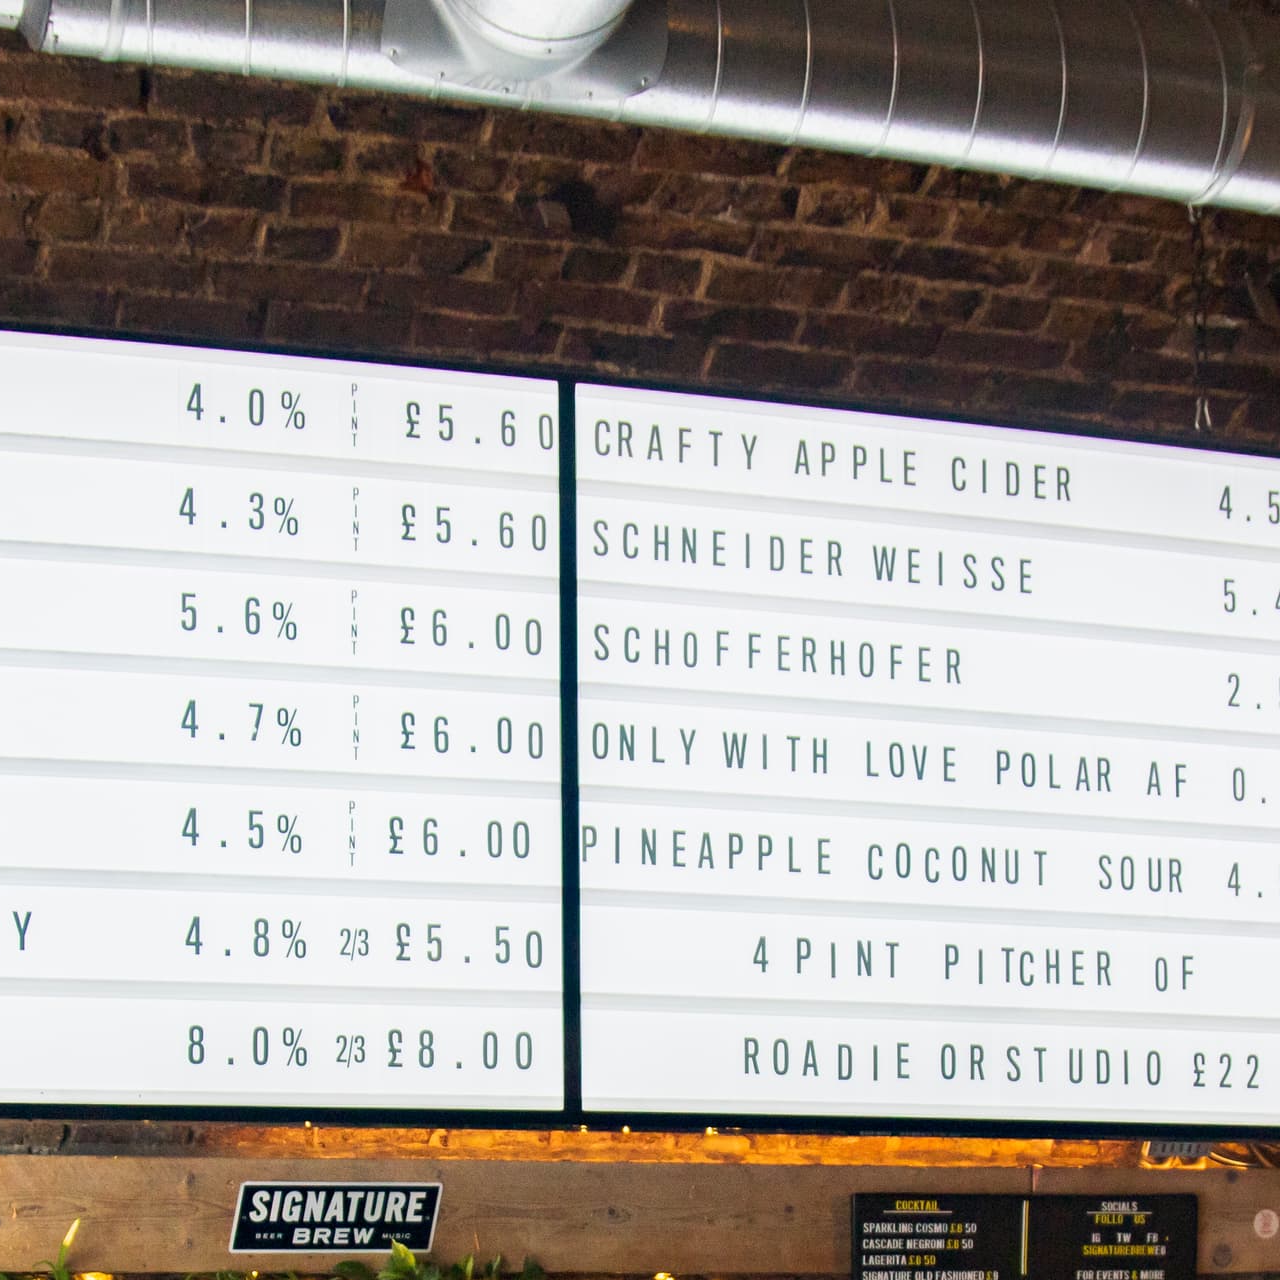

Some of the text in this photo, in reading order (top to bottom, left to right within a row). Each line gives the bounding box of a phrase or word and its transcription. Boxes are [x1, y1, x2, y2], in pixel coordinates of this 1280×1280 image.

[187, 383, 305, 429] 4.0%
[406, 401, 553, 450] £5.60
[595, 419, 1070, 501] CRAFTY APPLE CIDER
[179, 488, 298, 536] 4.3%
[401, 504, 546, 551] £5.60
[593, 520, 1032, 594] SCHNEIDER WEISSE
[181, 593, 297, 640] 5.6%
[400, 607, 541, 655] £6.00
[594, 624, 960, 684] SCHOFFERHOFER
[181, 700, 301, 747] 4.7%
[401, 712, 543, 759] £6.00
[592, 722, 1186, 798] ONLY WITH LOVE POLAR AF
[182, 808, 301, 853] 4.5%
[389, 816, 529, 858] £6.00
[581, 825, 1182, 893] PINEAPPLE COCONUT SOUR
[185, 916, 369, 961] 4.8% 2/3
[396, 923, 542, 968] £5.50
[753, 936, 1193, 992] 4 PINT PITCHER OF
[188, 1025, 365, 1068] 8.0% 2/3
[388, 1029, 532, 1070] £8.00
[744, 1037, 910, 1081] ROADIE
[1193, 1052, 1259, 1088] £22
[249, 1190, 427, 1223] SIGNATURE
[863, 1223, 948, 1233] SPARKLING COSMO
[1101, 1202, 1138, 1212] SOCIALS
[255, 1232, 283, 1240] BEER
[292, 1227, 375, 1245] BREW
[863, 1239, 945, 1249] CASCADE NEGRONI
[1117, 1232, 1131, 1243] TW
[862, 1255, 907, 1265] LAGERITA
[862, 1271, 984, 1280] SIGNATURE OLD FASHIONED
[1076, 1270, 1165, 1280] FOR EVENTS MORE
